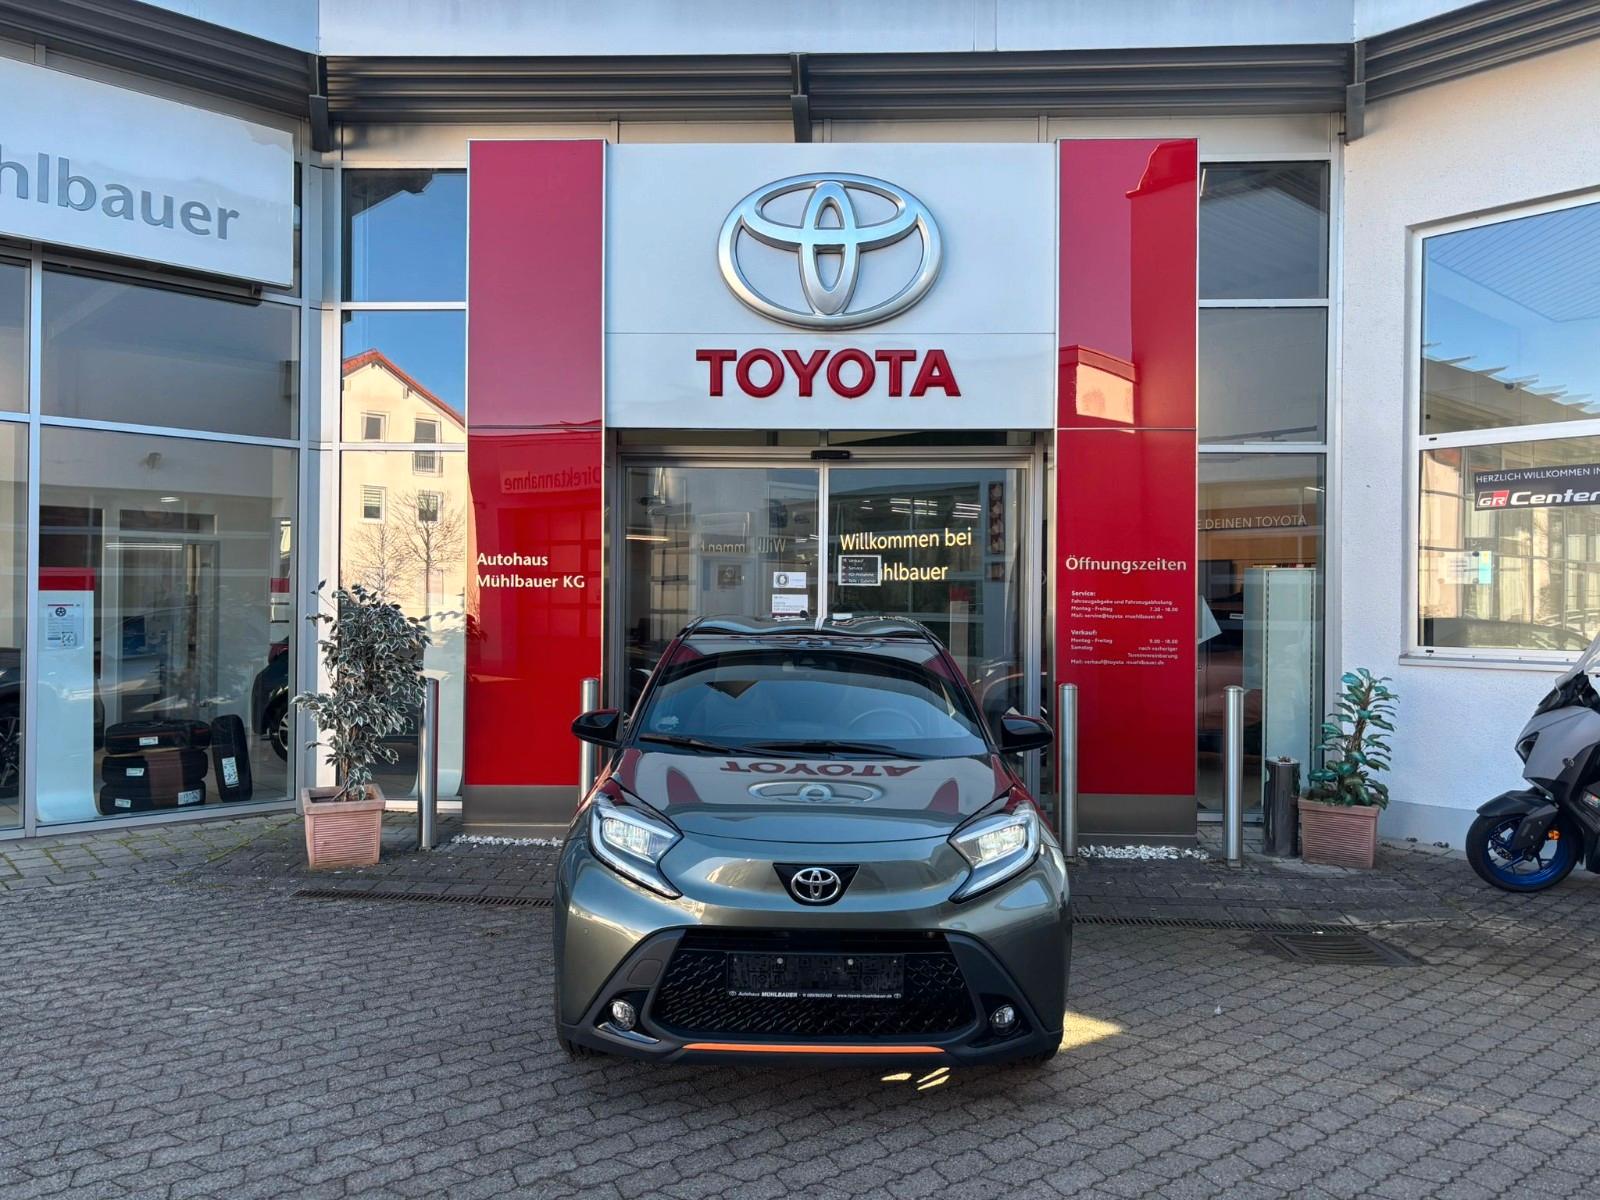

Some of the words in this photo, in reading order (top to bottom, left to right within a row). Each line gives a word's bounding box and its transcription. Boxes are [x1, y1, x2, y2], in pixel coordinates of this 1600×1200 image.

[695, 348, 961, 399] TOYOTA
[1476, 473, 1521, 483] HERZLICH
[1523, 468, 1590, 479] WILLKOMMEN
[1478, 494, 1507, 507] GR
[1510, 489, 1600, 506] Center
[1205, 517, 1252, 529] DEINEN
[1255, 514, 1308, 527] TOYOTA
[840, 532, 939, 551] Willkommen
[945, 527, 973, 547] bei
[477, 552, 548, 566] Autohaus
[1066, 555, 1187, 574] Öffnungszeiten
[880, 562, 948, 581] hlbauer
[476, 574, 558, 588] Mühlbauer
[563, 575, 585, 588] KG
